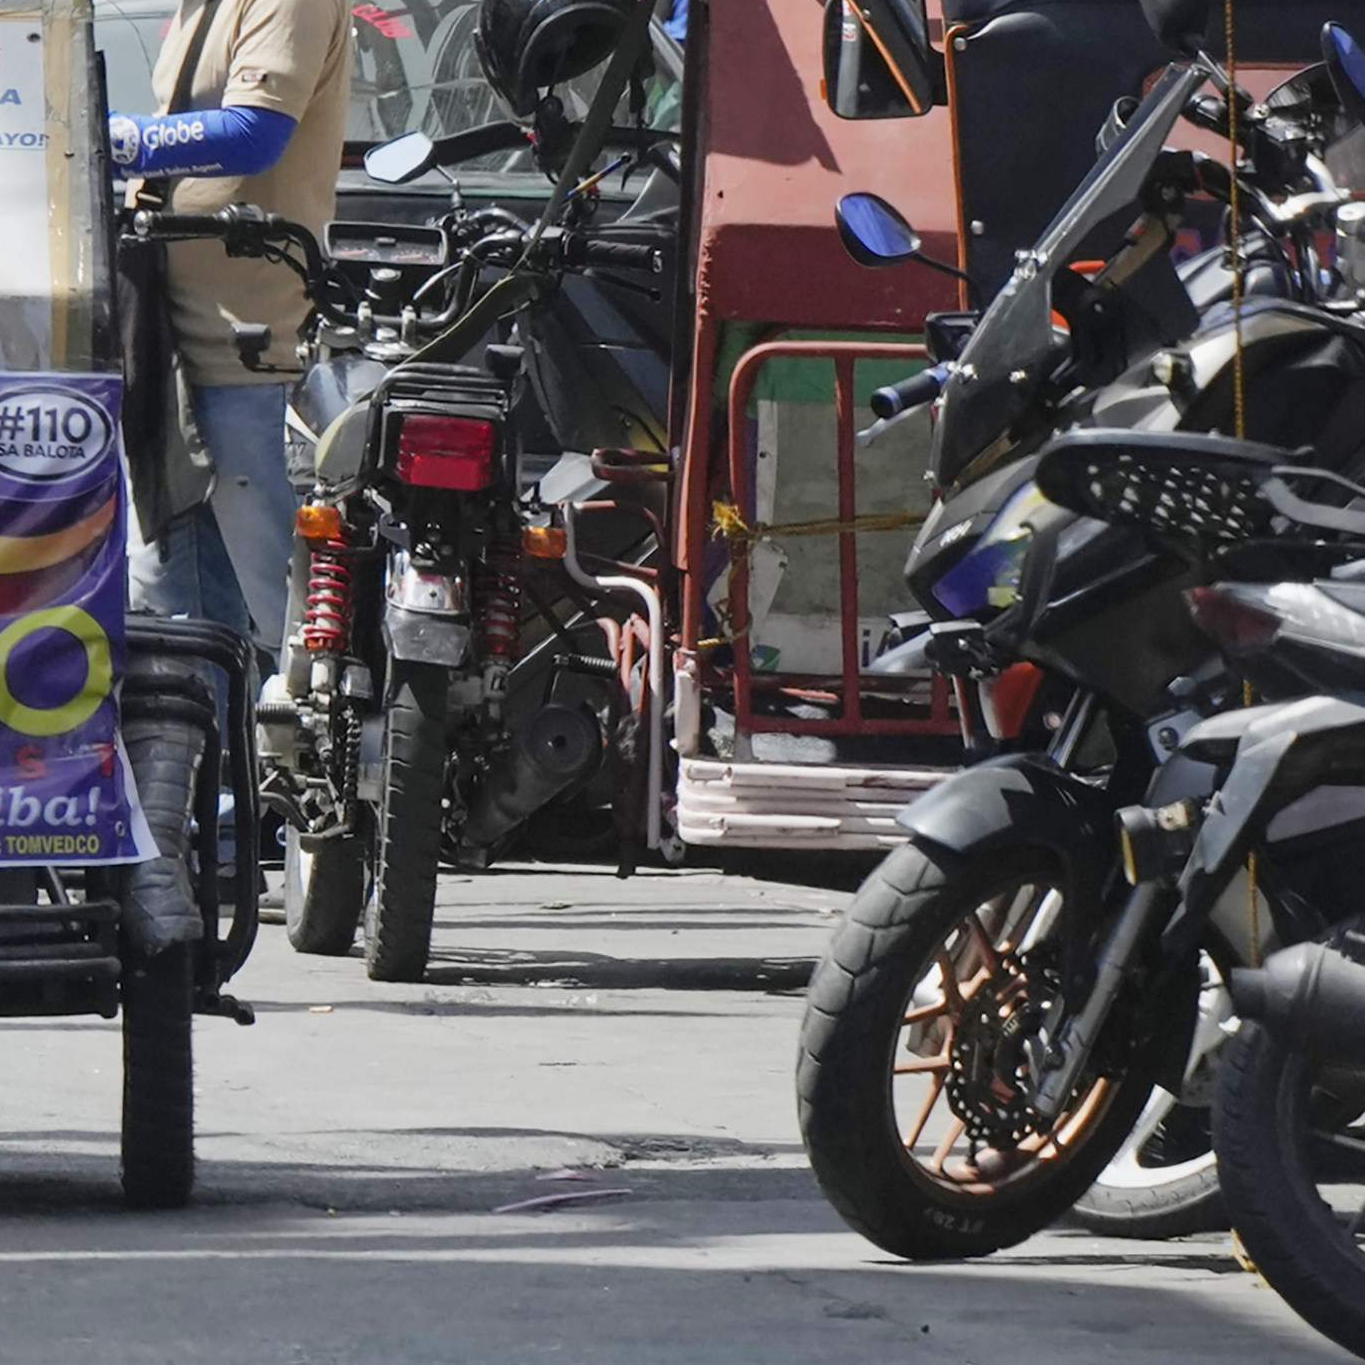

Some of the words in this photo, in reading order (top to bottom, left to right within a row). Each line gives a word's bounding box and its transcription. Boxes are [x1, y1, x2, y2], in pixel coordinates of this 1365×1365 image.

[142, 119, 206, 152] Globe
[20, 443, 88, 461] BALOTA
[6, 834, 100, 854] TOMVEDCO
